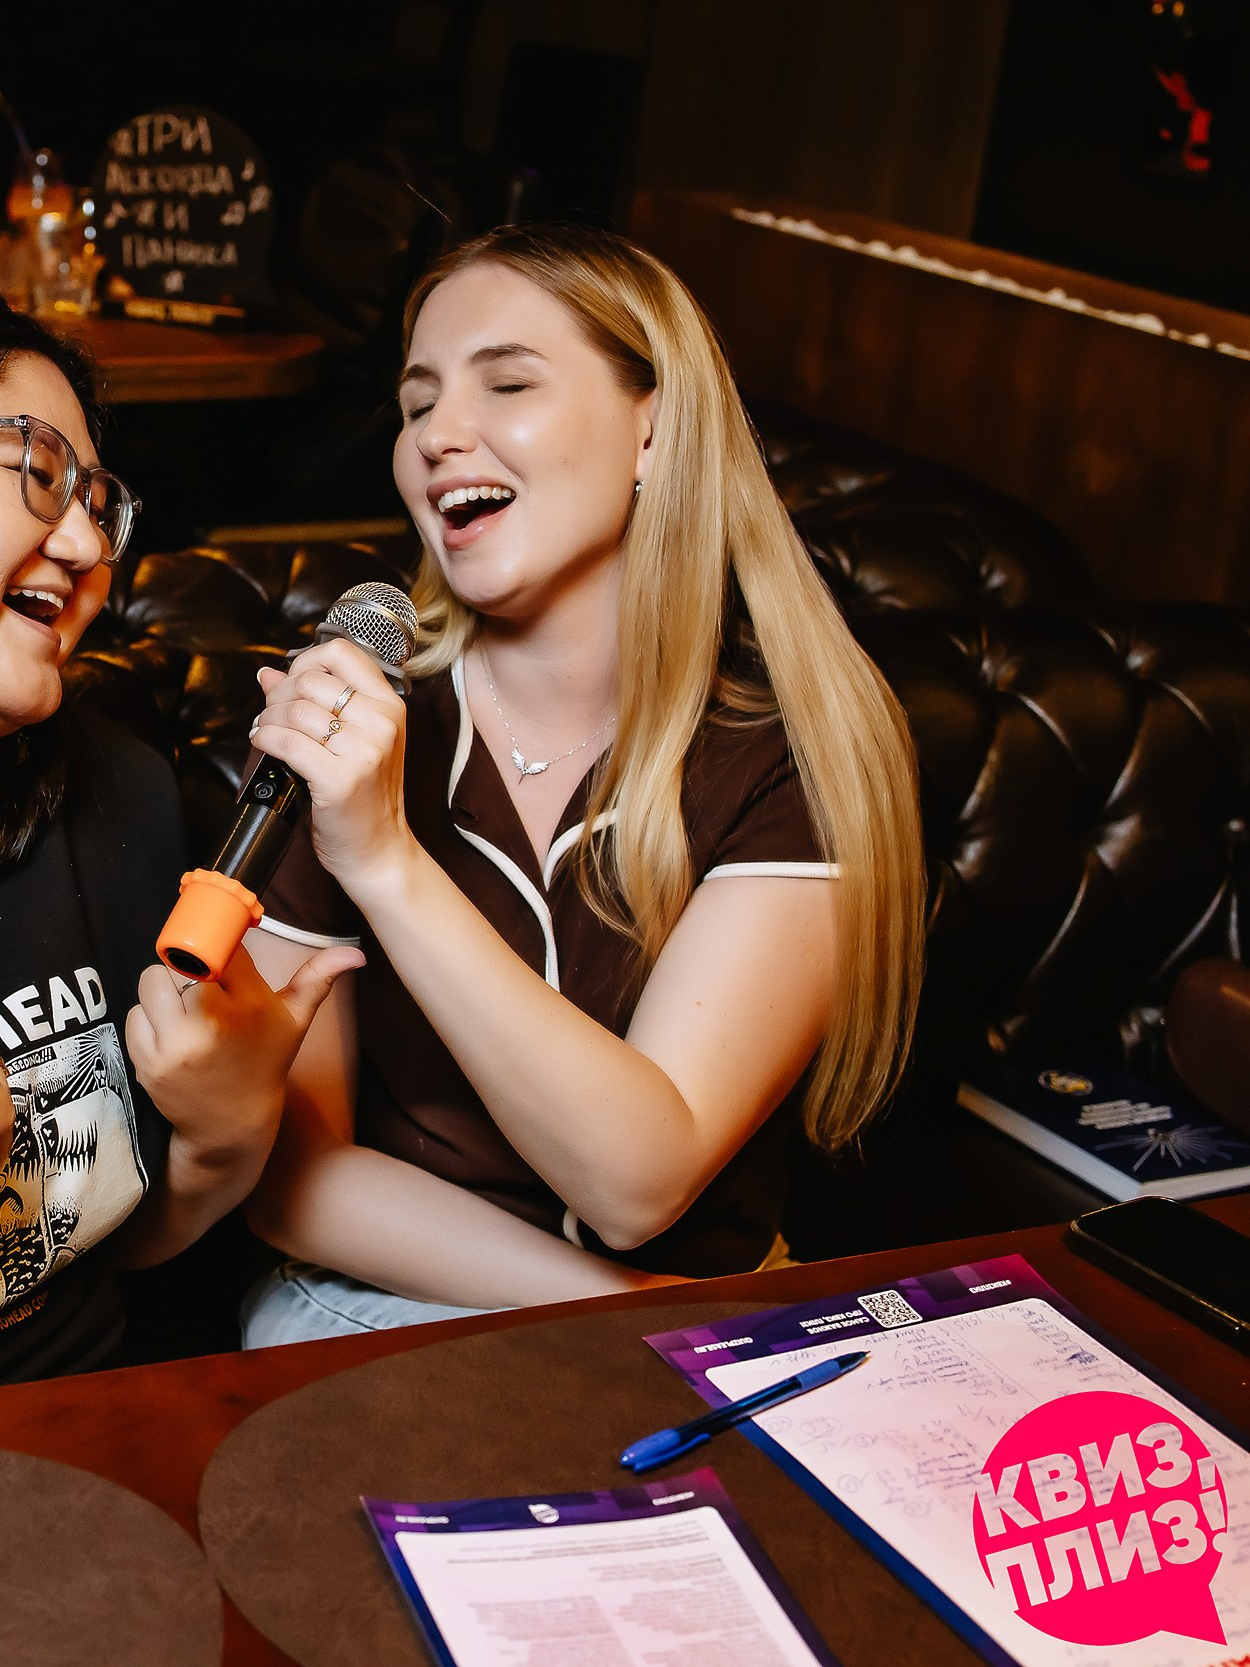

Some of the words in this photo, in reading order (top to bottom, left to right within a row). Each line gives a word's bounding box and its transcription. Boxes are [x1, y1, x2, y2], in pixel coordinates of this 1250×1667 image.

[845, 1309, 864, 1319] ПРО
[840, 1316, 870, 1328] САМОЕ
[806, 1322, 842, 1335] ВАЖНОЕ
